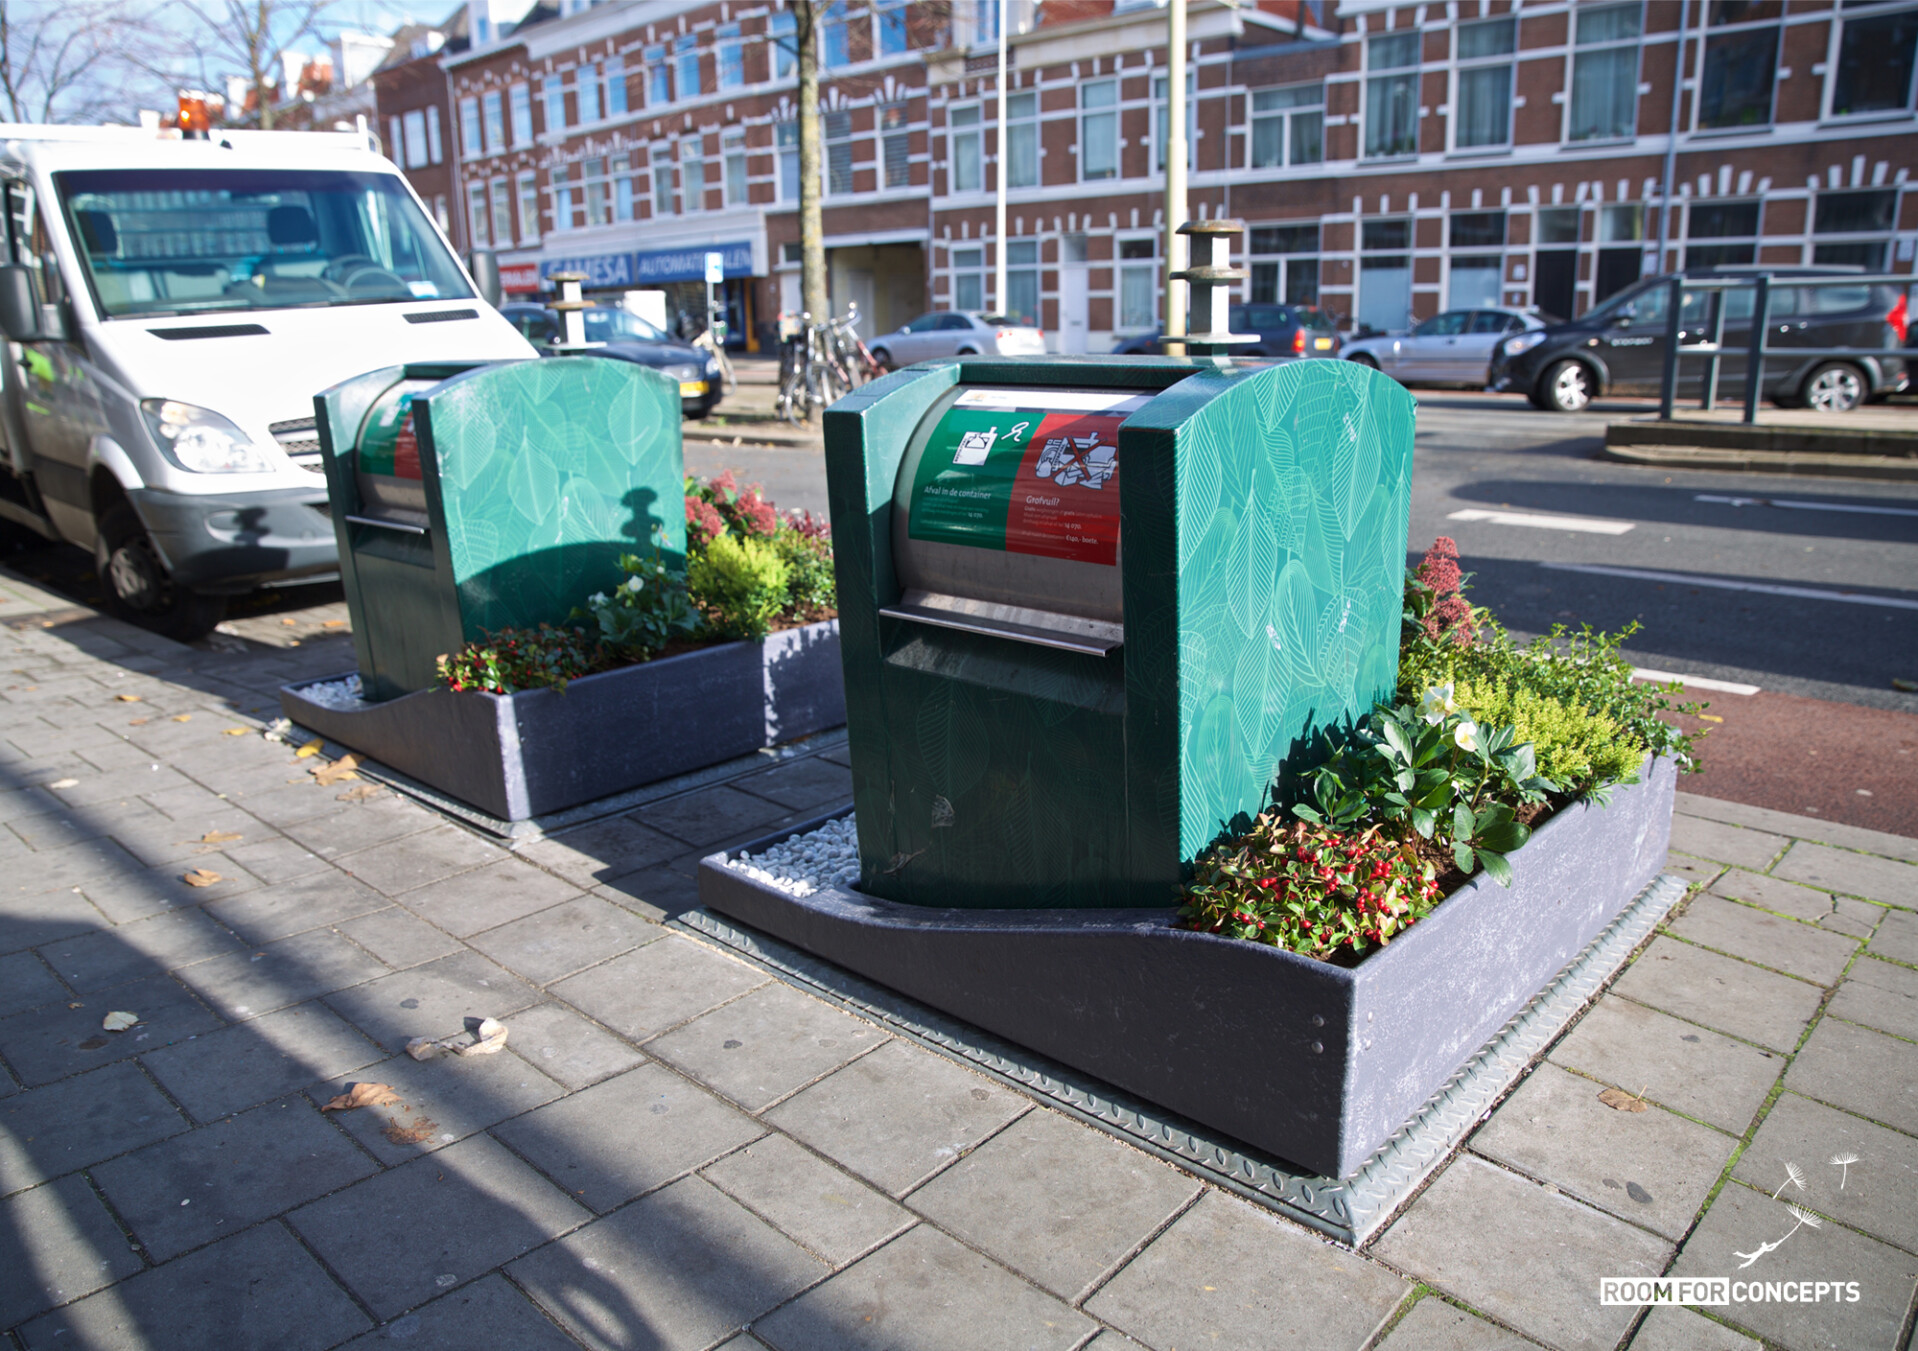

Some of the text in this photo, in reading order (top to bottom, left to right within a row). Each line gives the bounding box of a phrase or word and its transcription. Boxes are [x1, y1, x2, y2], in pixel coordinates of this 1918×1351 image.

[924, 486, 940, 495] Afval
[949, 488, 957, 497] de
[958, 489, 991, 499] container
[1026, 495, 1060, 506] Grofvuil?
